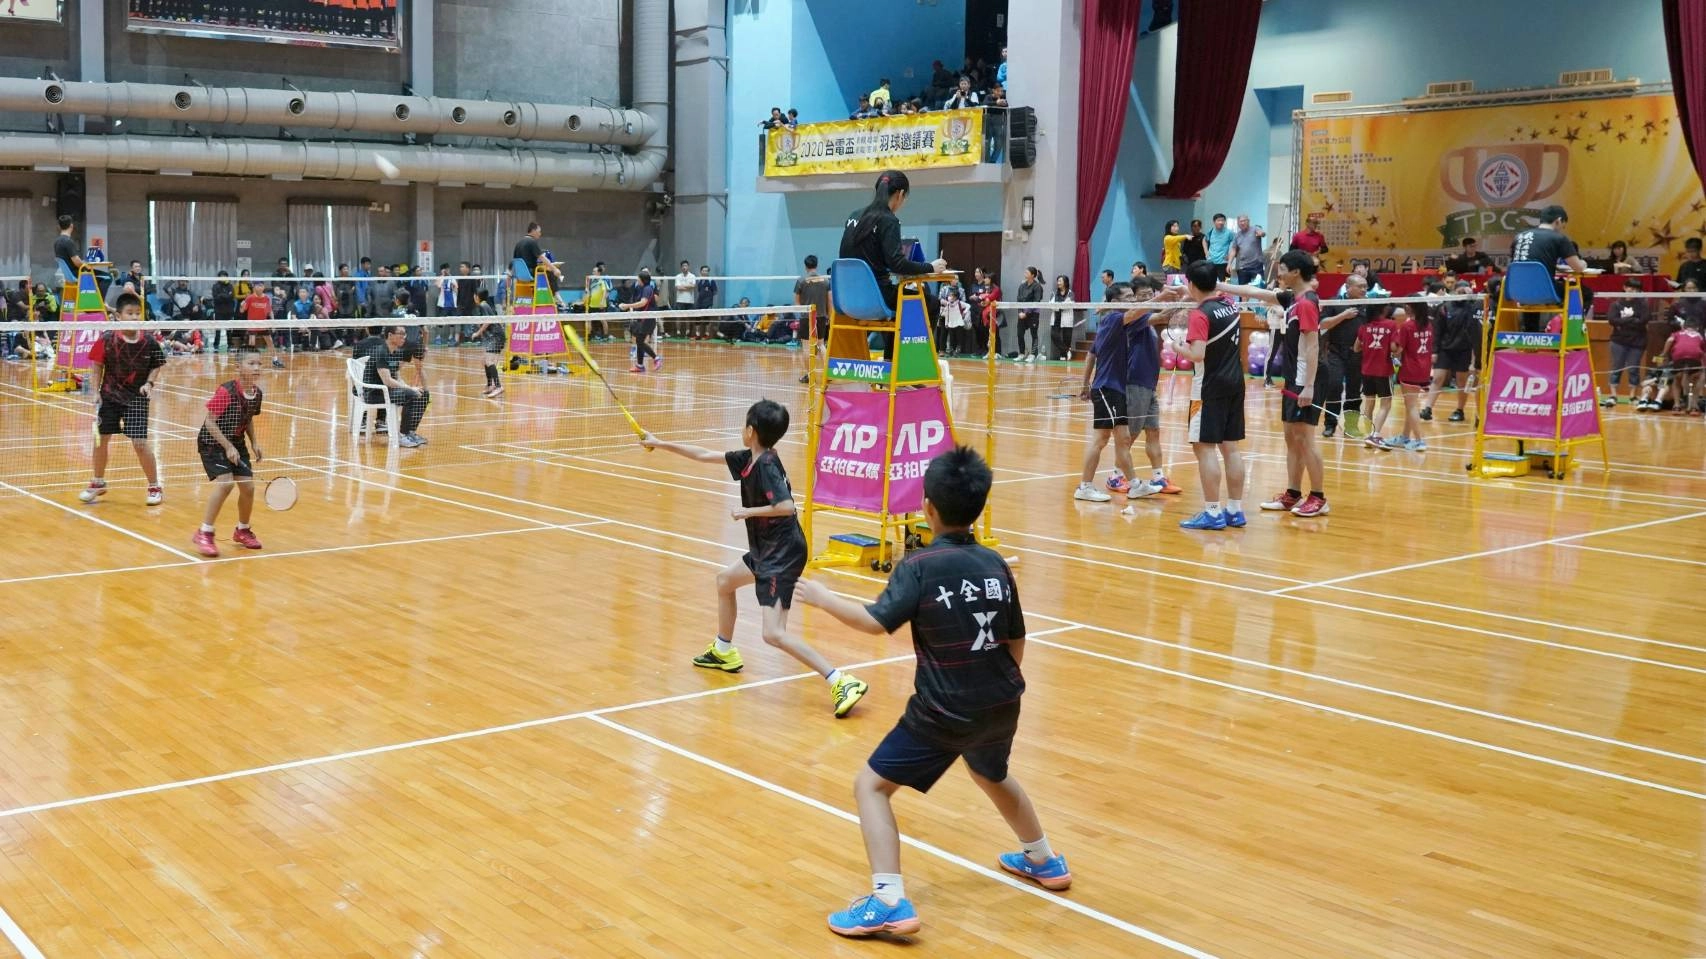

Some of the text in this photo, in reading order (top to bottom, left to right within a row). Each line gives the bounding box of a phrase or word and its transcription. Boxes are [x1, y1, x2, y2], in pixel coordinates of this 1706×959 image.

[880, 130, 935, 152] 羽球邀請賽
[1521, 335, 1554, 346] YONEX
[853, 363, 885, 379] YONEX
[1500, 376, 1549, 399] AP
[1564, 373, 1591, 399] AP
[830, 422, 878, 454] AP
[893, 420, 945, 456] AP
[889, 458, 931, 481] 亞柏E
